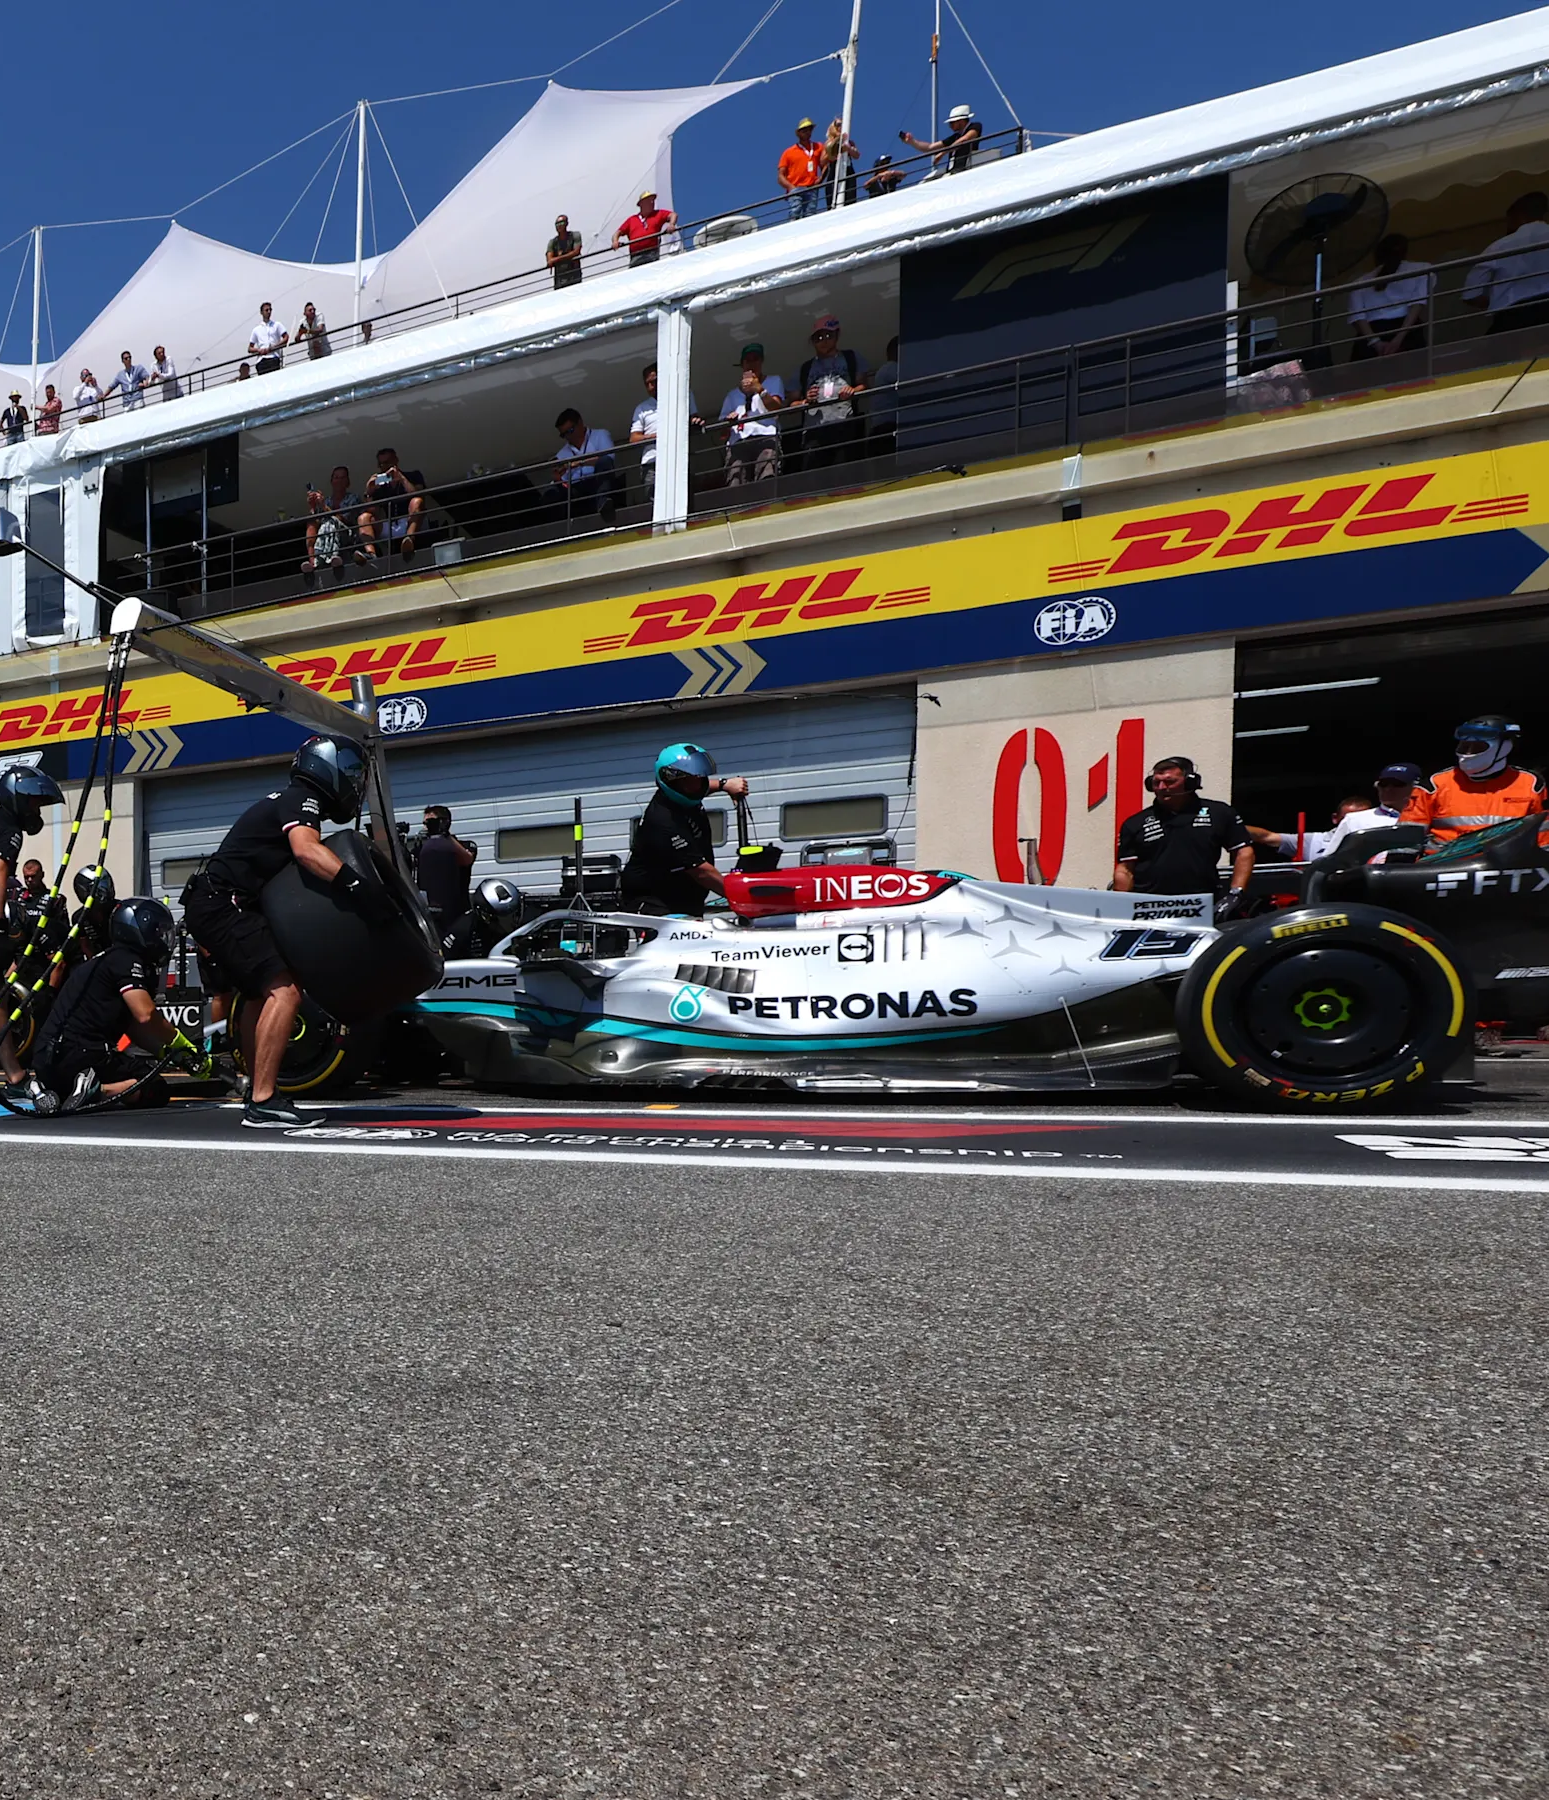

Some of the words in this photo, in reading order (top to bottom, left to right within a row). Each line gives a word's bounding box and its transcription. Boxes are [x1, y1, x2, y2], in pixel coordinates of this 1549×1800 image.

[1105, 473, 1457, 575] DHL
[625, 567, 878, 647] DHL
[275, 637, 459, 692] DHL
[992, 718, 1145, 891] 01
[813, 874, 931, 903] INEOS
[1131, 905, 1207, 921] PRIMAX
[1133, 898, 1203, 910] PETRONAS
[669, 931, 702, 941] AMD
[1270, 913, 1350, 939] PIRELLI
[711, 944, 831, 963] TeamViewer
[156, 1005, 200, 1027] WC
[727, 988, 979, 1020] PETRONAS
